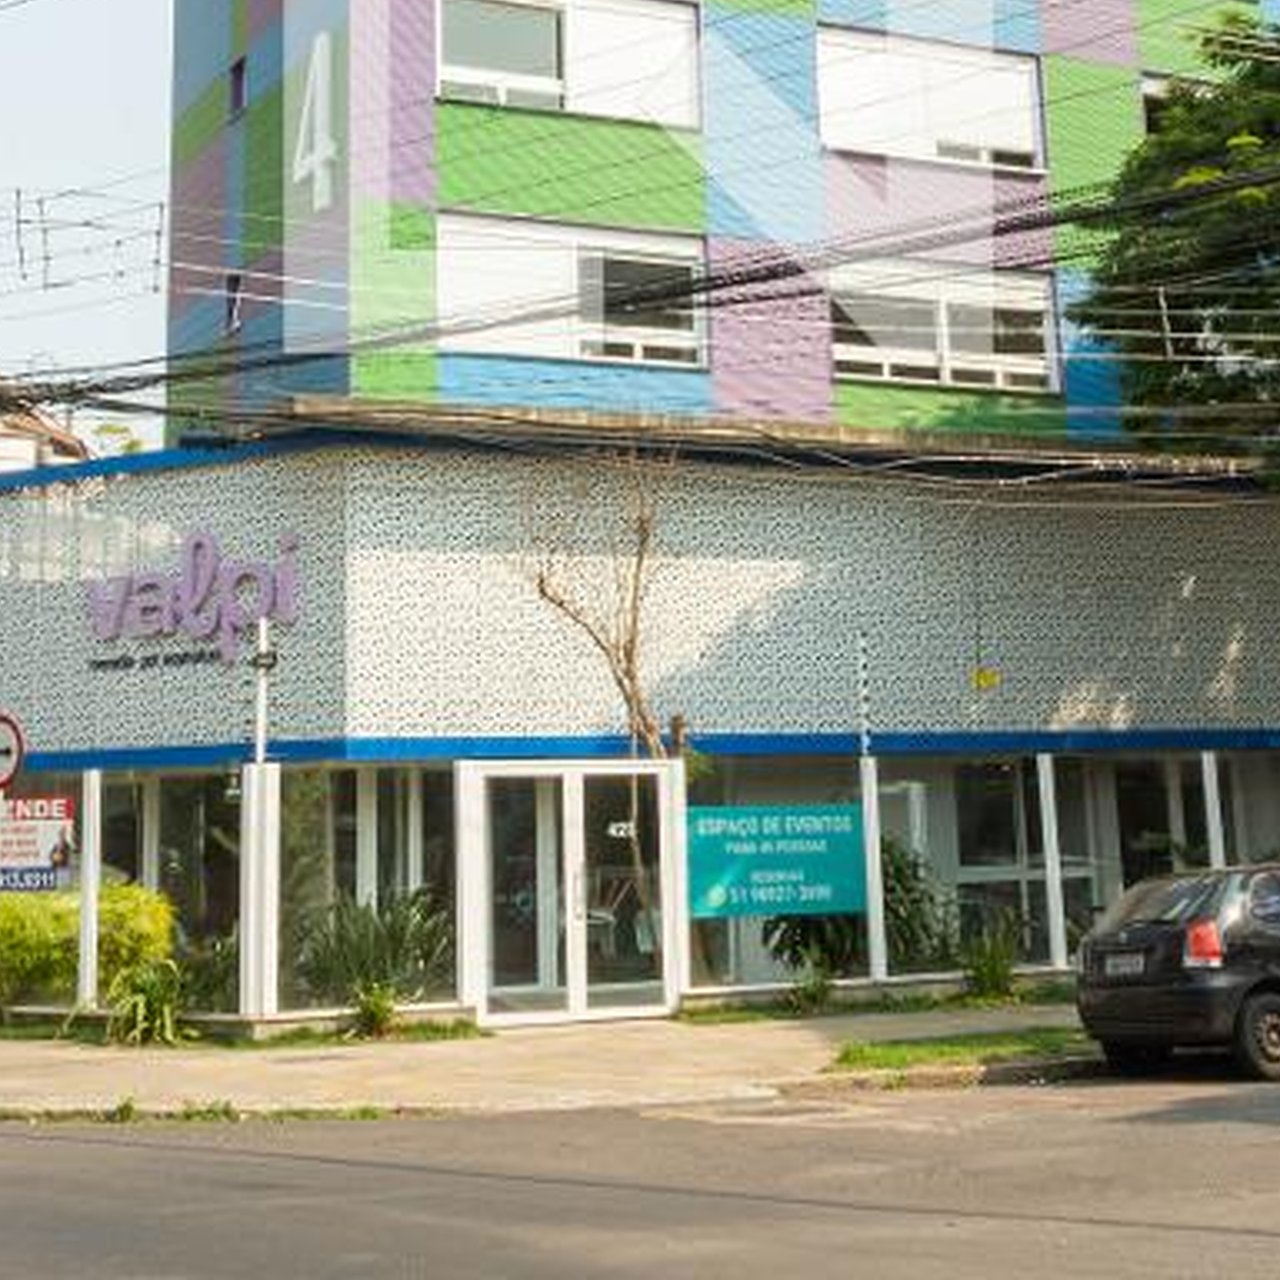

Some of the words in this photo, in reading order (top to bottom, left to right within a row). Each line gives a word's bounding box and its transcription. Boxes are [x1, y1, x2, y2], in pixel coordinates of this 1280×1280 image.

[292, 30, 338, 212] 4
[762, 816, 783, 835] DE
[785, 814, 852, 834] EVENTOS
